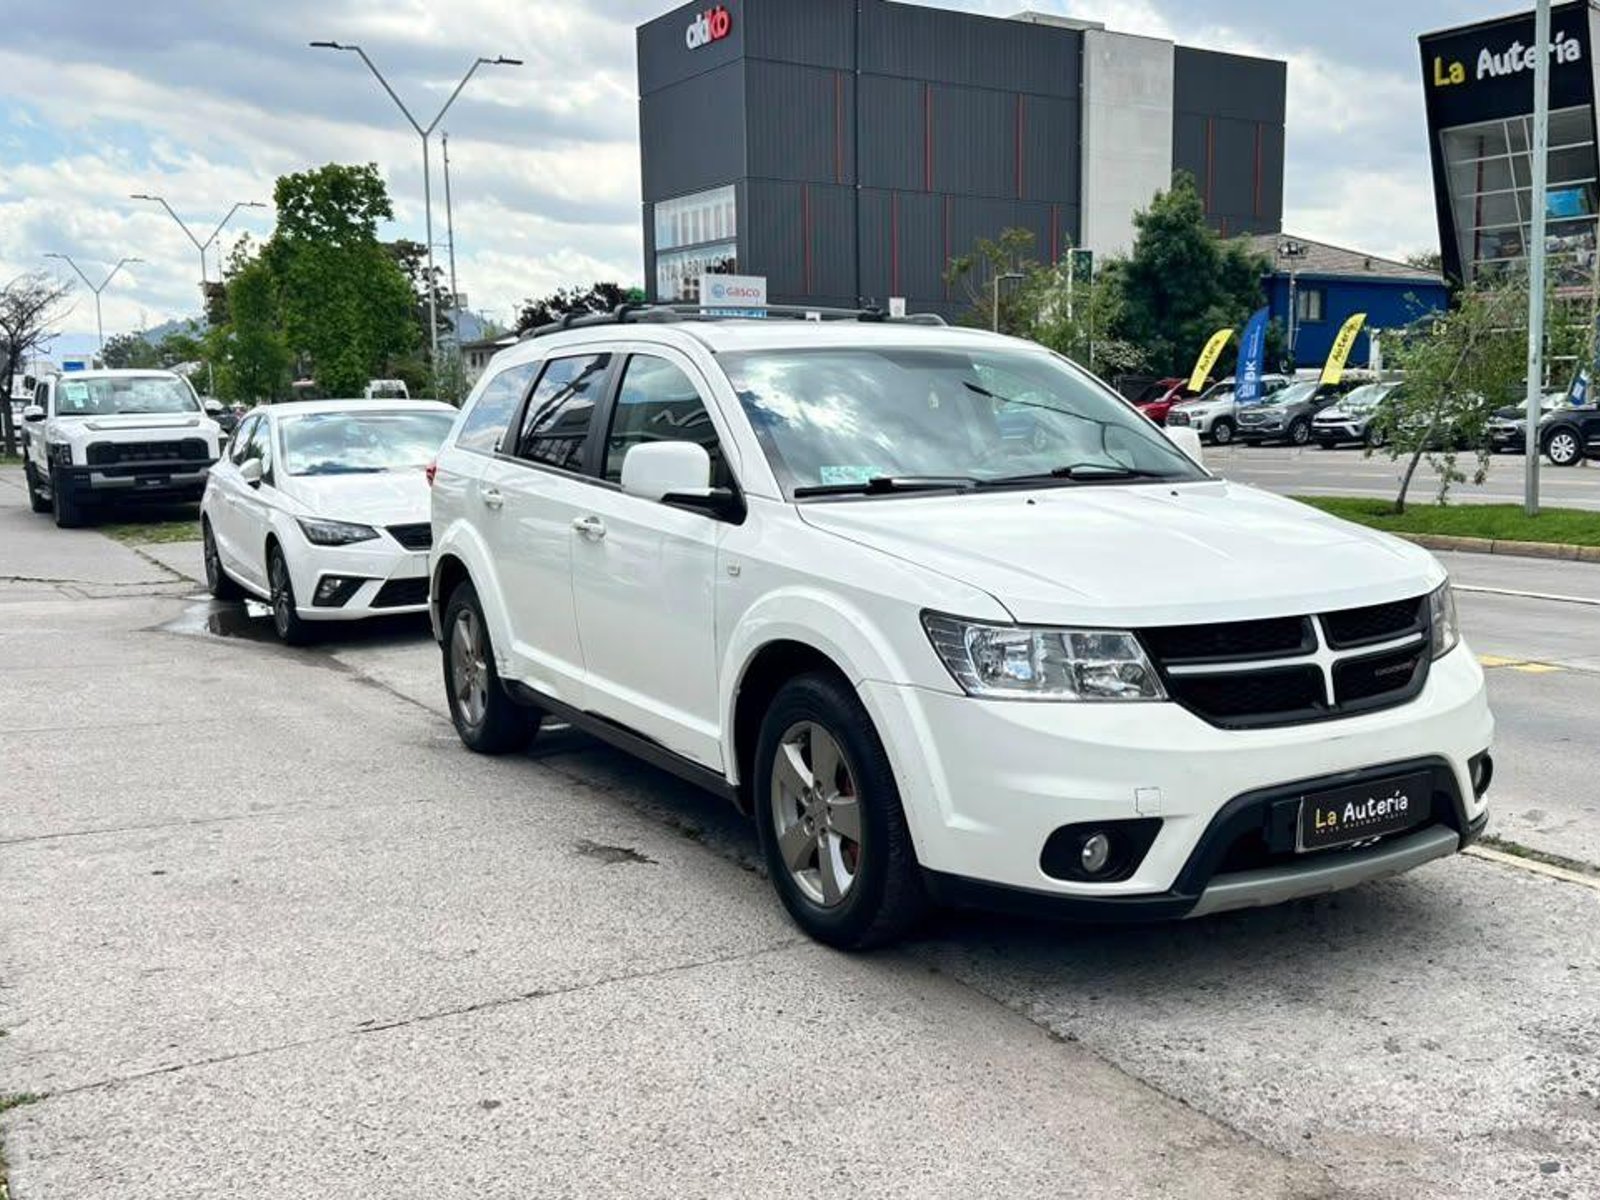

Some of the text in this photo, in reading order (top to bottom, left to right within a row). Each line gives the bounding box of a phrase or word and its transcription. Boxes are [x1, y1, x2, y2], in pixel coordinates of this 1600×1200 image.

[1434, 55, 1466, 87] La
[1315, 808, 1337, 829] La
[1342, 789, 1408, 823] Autería
